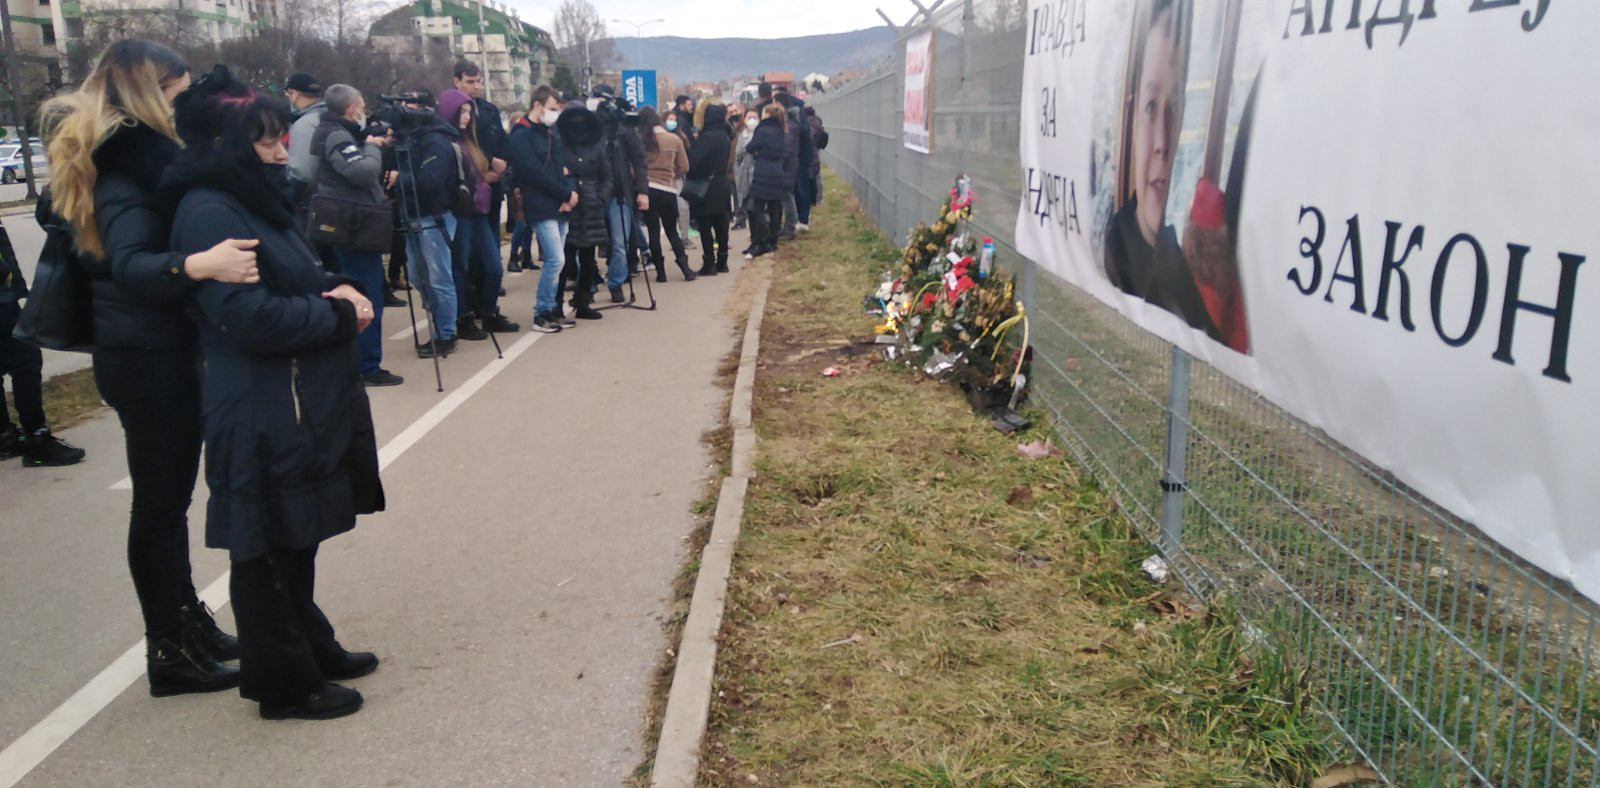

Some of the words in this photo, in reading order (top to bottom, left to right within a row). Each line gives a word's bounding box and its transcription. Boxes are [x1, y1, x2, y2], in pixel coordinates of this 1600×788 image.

[626, 75, 638, 109] ODA
[1040, 86, 1057, 138] ЗА
[1022, 167, 1082, 240] НДРЕЈА
[1286, 204, 1587, 384] ЗАКОН
